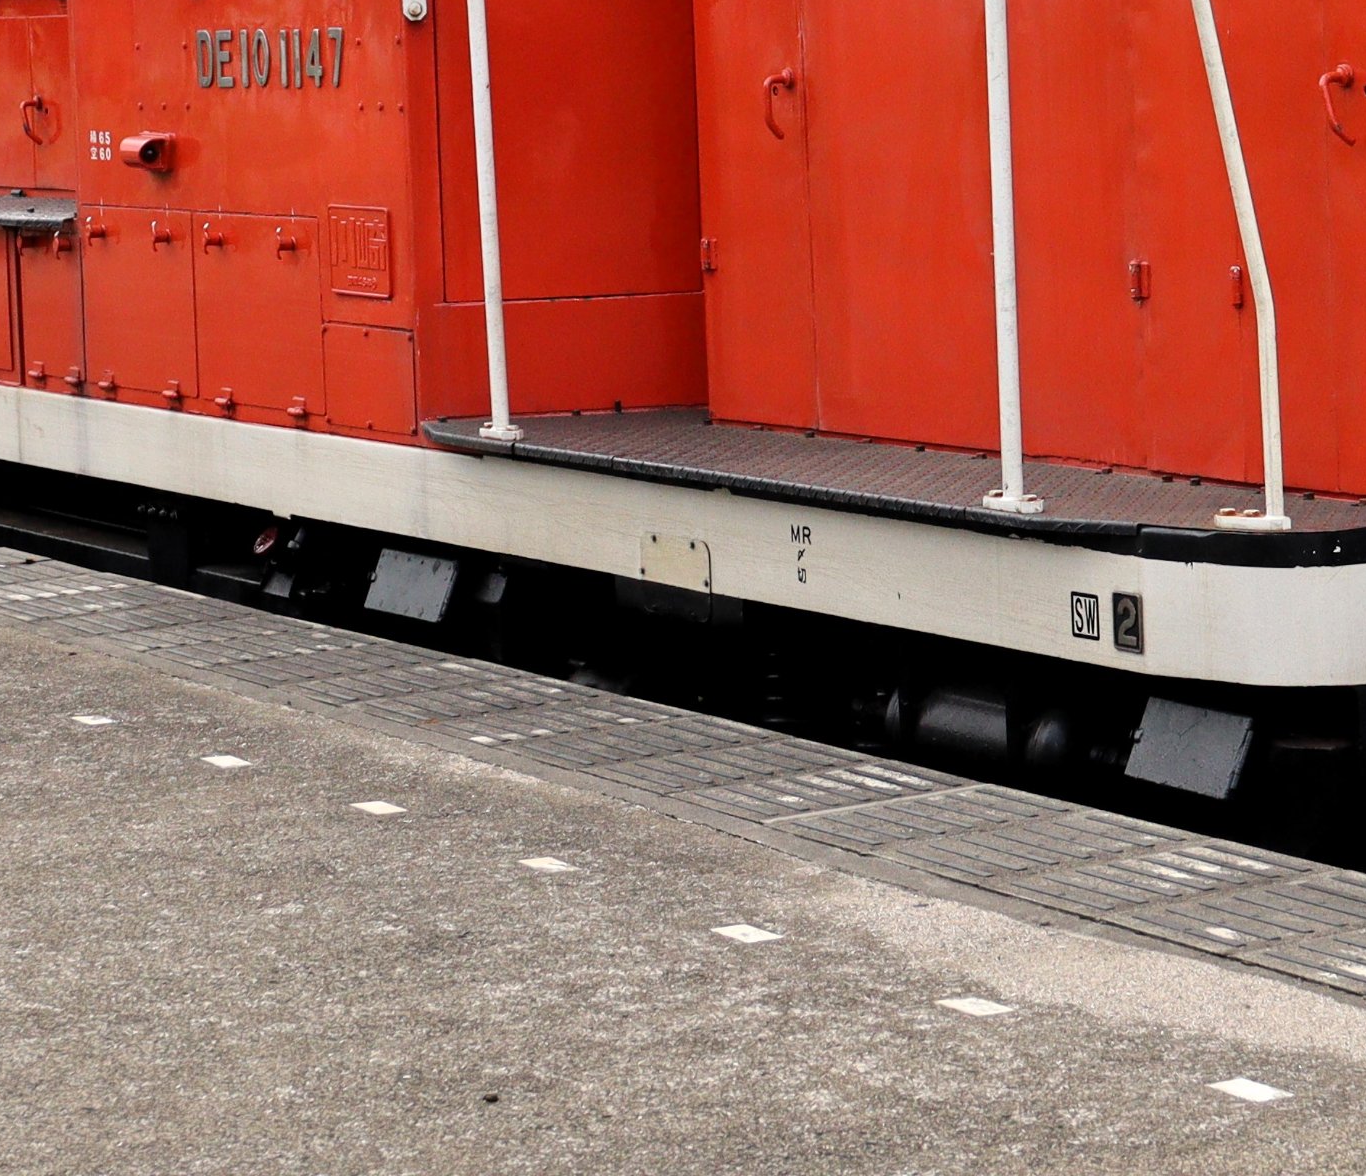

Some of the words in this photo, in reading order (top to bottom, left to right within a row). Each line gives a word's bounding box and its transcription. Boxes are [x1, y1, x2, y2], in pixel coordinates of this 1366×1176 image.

[279, 26, 344, 89] 1147
[790, 523, 812, 545] MR
[1075, 597, 1096, 635] SW
[1117, 597, 1137, 646] 2
